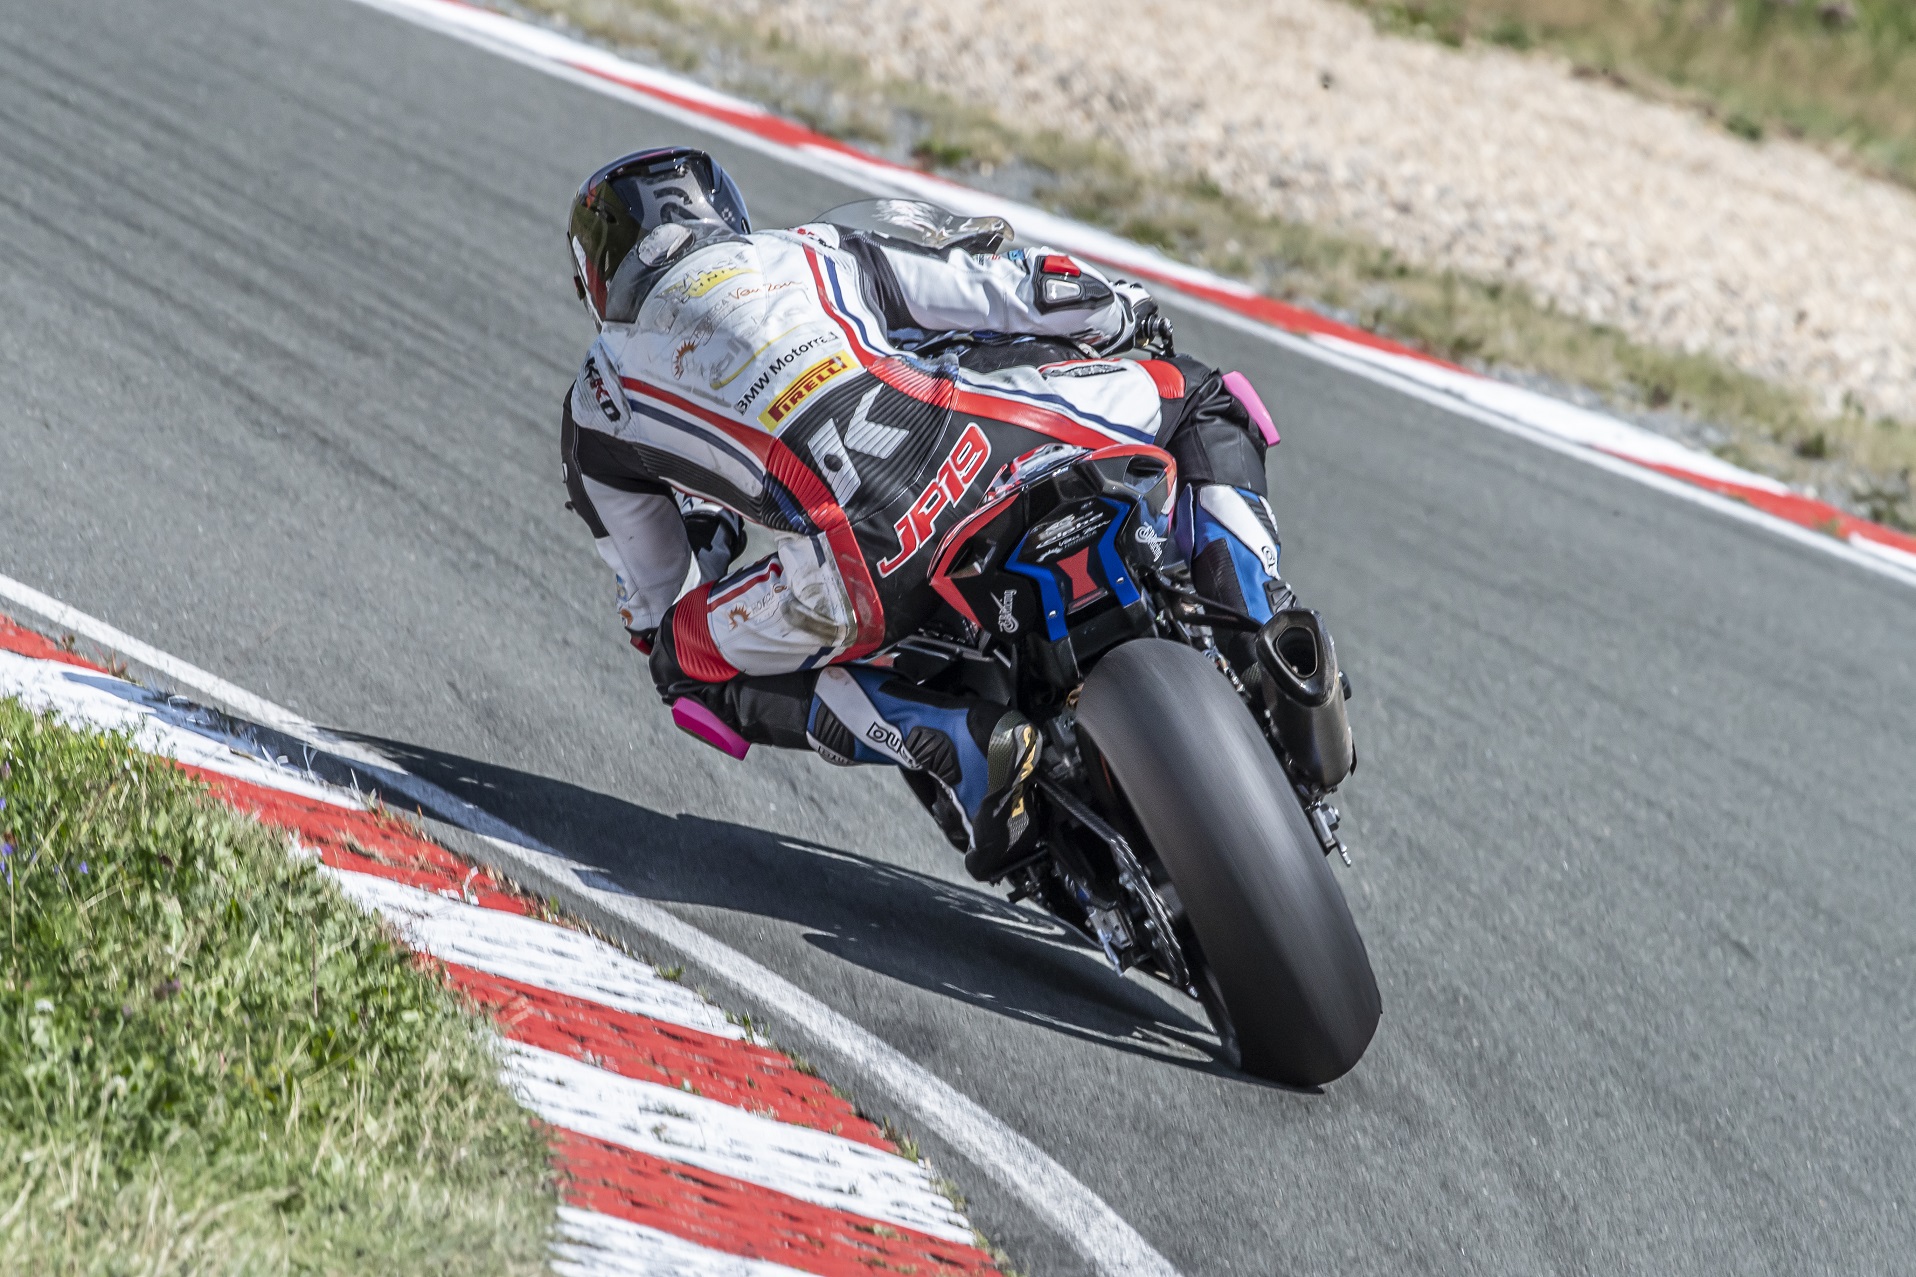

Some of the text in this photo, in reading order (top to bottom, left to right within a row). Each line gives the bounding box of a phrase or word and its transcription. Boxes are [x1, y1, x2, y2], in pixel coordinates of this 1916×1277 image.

[735, 372, 771, 416] BMW
[768, 356, 848, 423] PIRELLI
[876, 421, 992, 579] JP19
